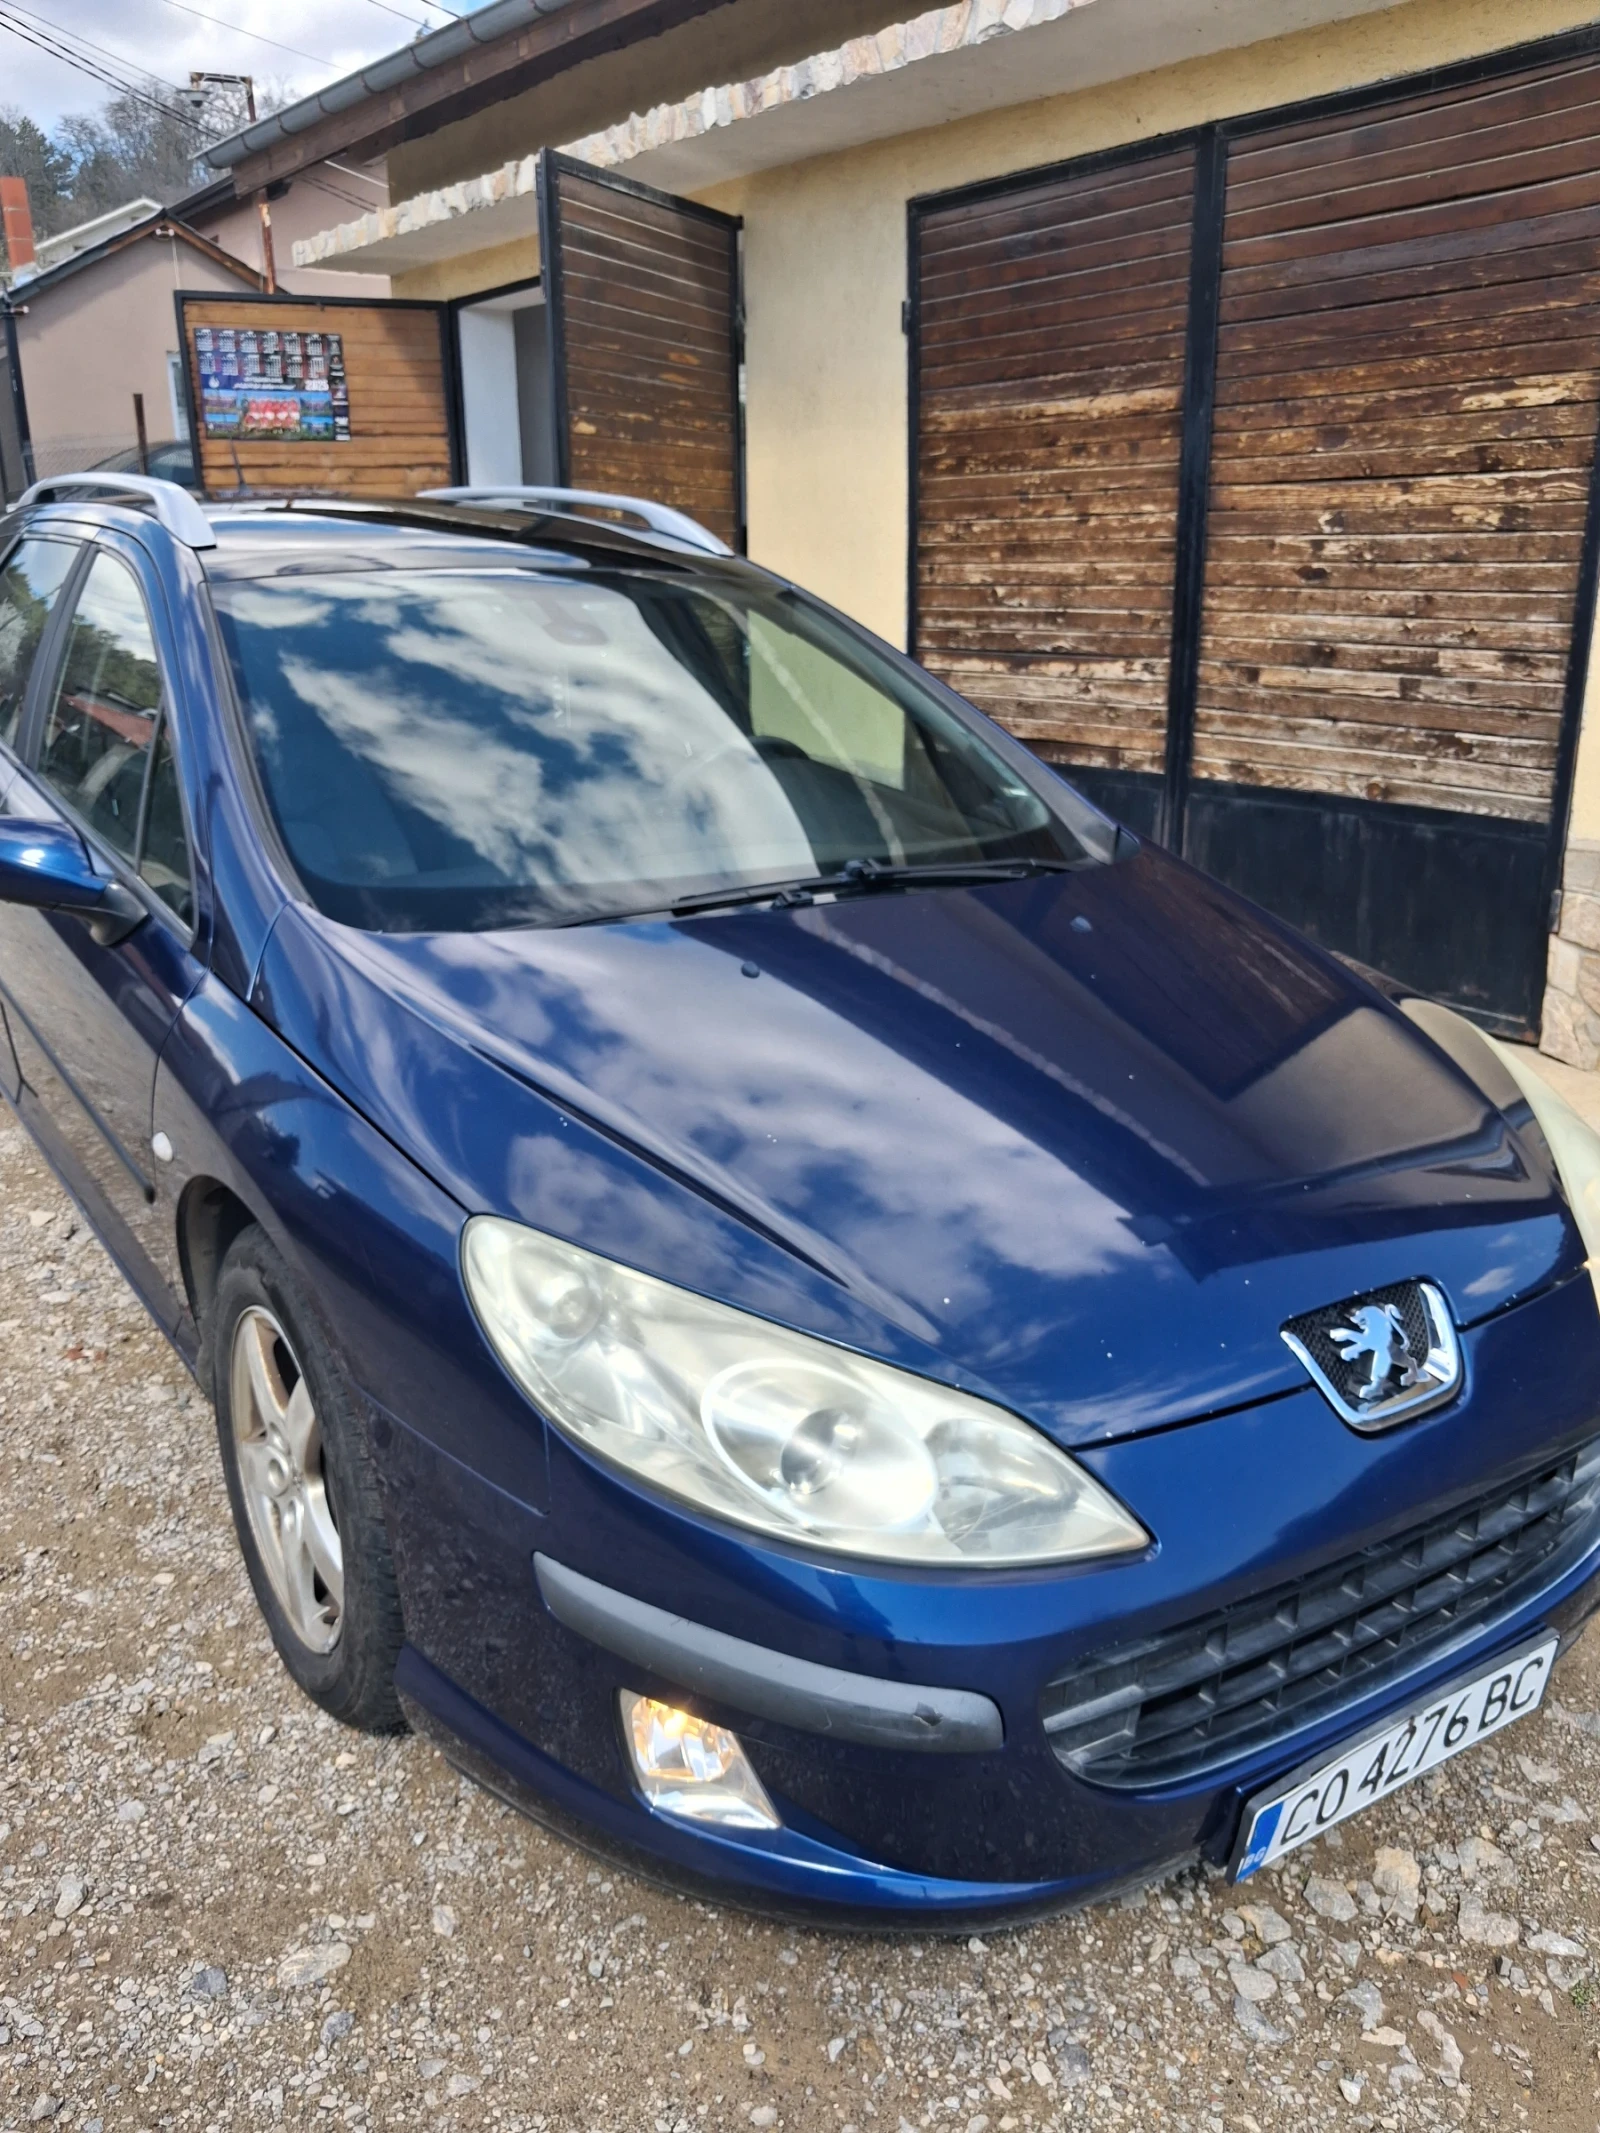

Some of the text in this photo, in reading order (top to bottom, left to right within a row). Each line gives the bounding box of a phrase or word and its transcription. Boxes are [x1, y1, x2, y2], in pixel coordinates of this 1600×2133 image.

[1280, 1656, 1545, 1846] CO 4276 BC
[1241, 1846, 1267, 1871] BG
